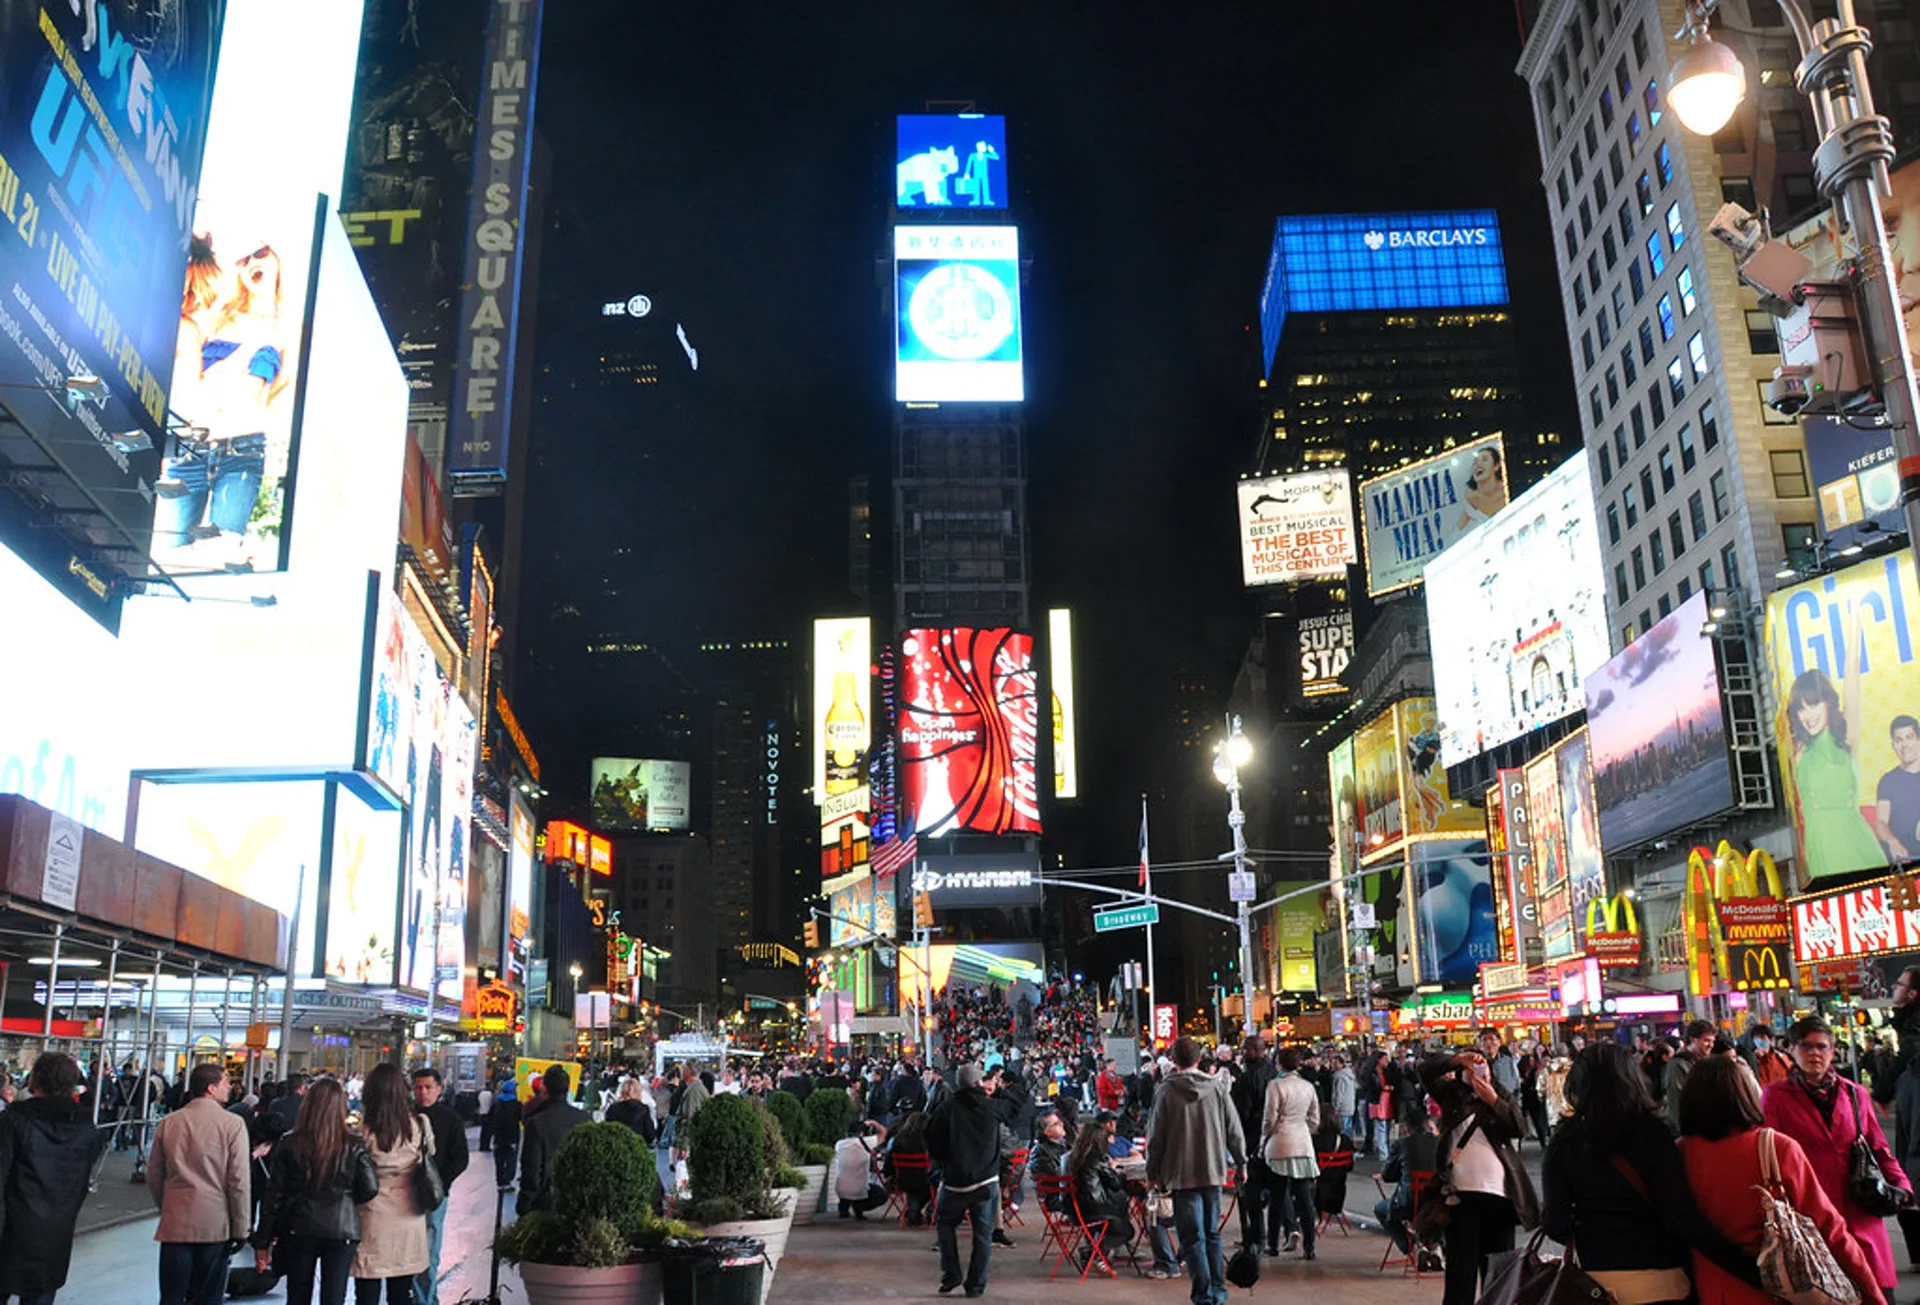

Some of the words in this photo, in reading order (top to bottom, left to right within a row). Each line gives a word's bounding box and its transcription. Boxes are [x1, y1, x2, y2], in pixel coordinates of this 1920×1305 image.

[1389, 229, 1486, 247] BARCLAYS
[466, 183, 516, 412] SQUARE
[18, 193, 39, 249] 21
[47, 231, 79, 304] LIVE
[76, 274, 101, 338] ON
[96, 317, 166, 428] PAY-PER-VIEW
[462, 441, 491, 452] NYC
[1848, 447, 1895, 472] KIEFER
[1372, 468, 1458, 530] MAMMA
[1250, 523, 1281, 537] BEST
[1287, 516, 1346, 532] MUSICAL
[1252, 533, 1291, 553] THE
[1299, 527, 1347, 548] BEST
[1391, 512, 1445, 564] MIA!
[1252, 547, 1321, 565] MUSICAL
[1325, 542, 1348, 559] OF
[1254, 563, 1284, 576] THIS
[1299, 615, 1328, 631] JESUS
[1786, 555, 1914, 680] Girl
[766, 734, 779, 824] NOVOTEL
[946, 870, 1032, 888] HYUNDAI
[1104, 913, 1149, 927] Broadway
[1722, 903, 1786, 915] McDonald's
[1587, 936, 1639, 946] McDonald's
